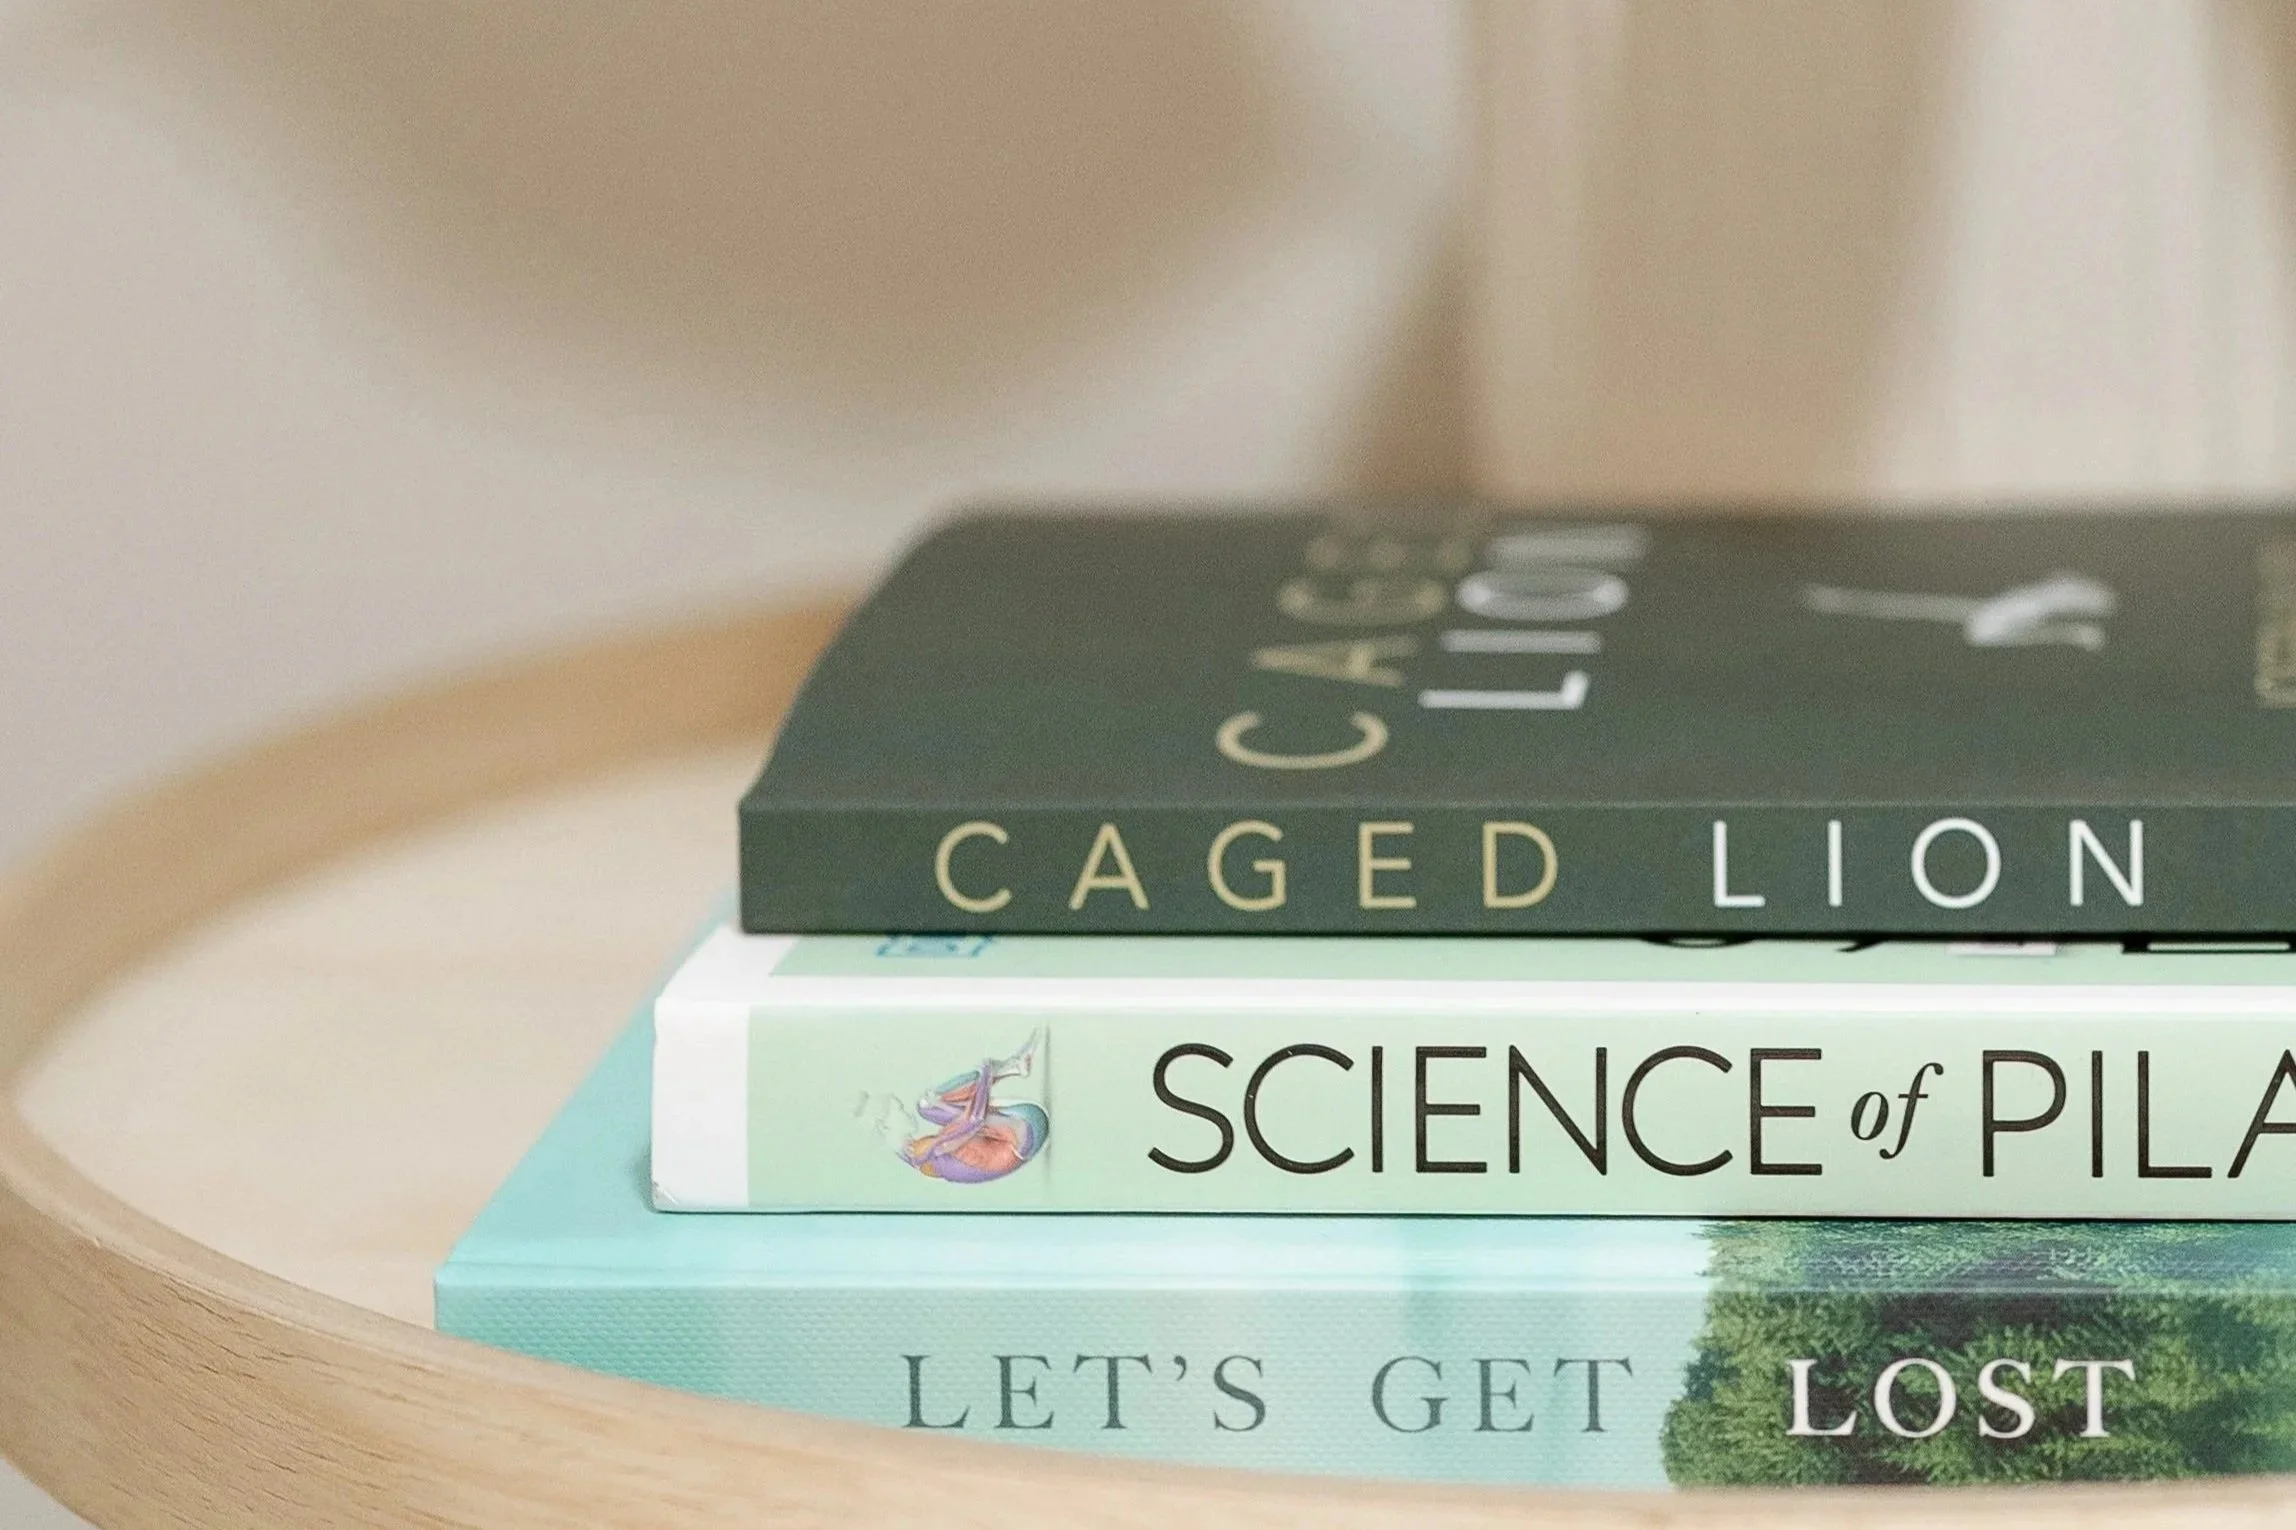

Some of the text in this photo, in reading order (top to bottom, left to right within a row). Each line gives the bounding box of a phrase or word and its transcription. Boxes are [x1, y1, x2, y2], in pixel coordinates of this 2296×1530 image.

[934, 817, 2146, 914] CAGED LION
[1147, 1042, 2296, 1180] SCIENCE of PILA
[900, 1353, 2136, 1439] LET’S GET LOST
